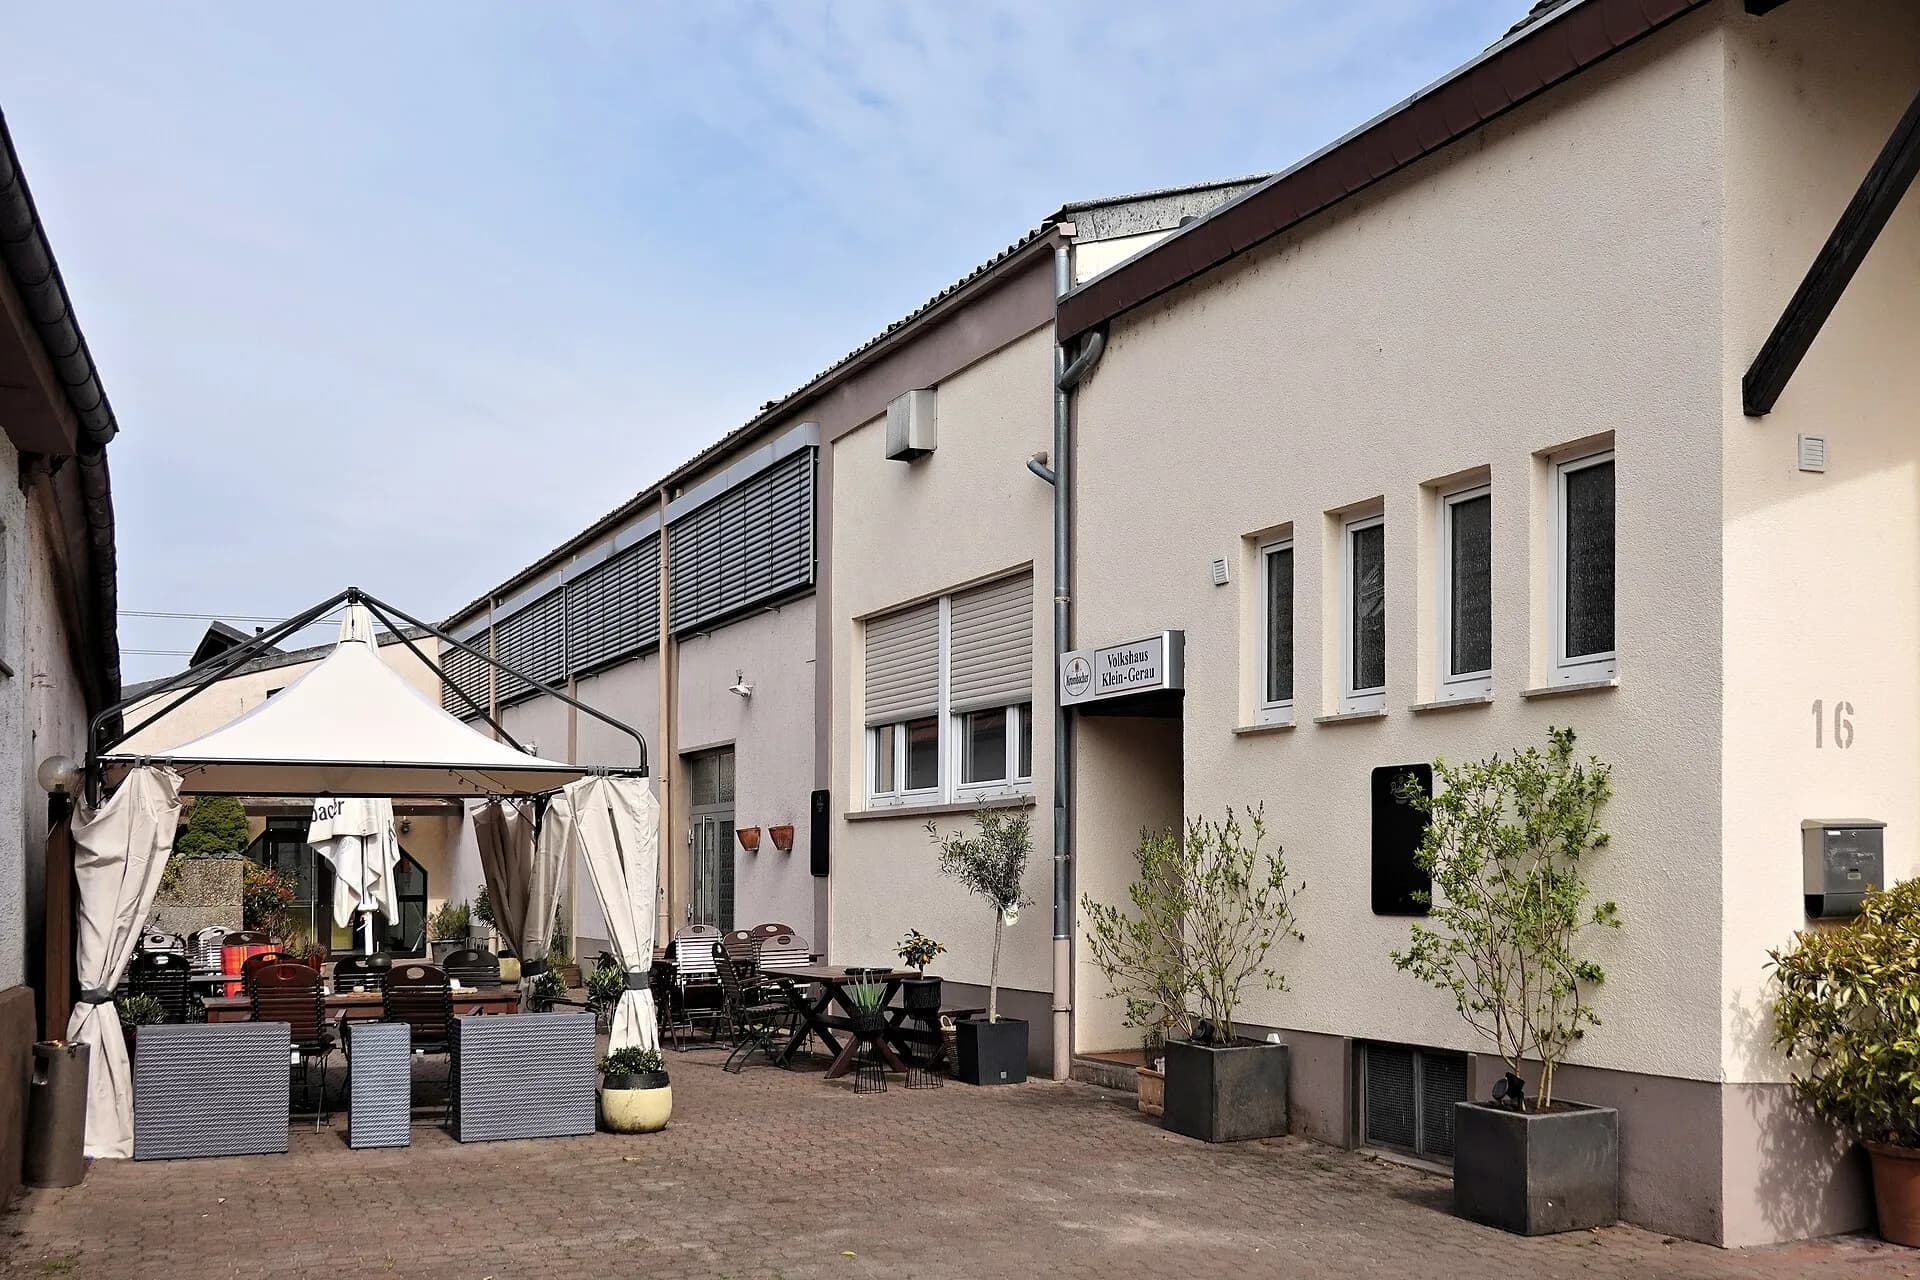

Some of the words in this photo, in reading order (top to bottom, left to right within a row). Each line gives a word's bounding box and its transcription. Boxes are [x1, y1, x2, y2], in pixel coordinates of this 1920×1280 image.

[1107, 650, 1149, 669] Volkshaus
[1102, 667, 1155, 687] Klein-Gerau
[1811, 698, 1854, 750] 16
